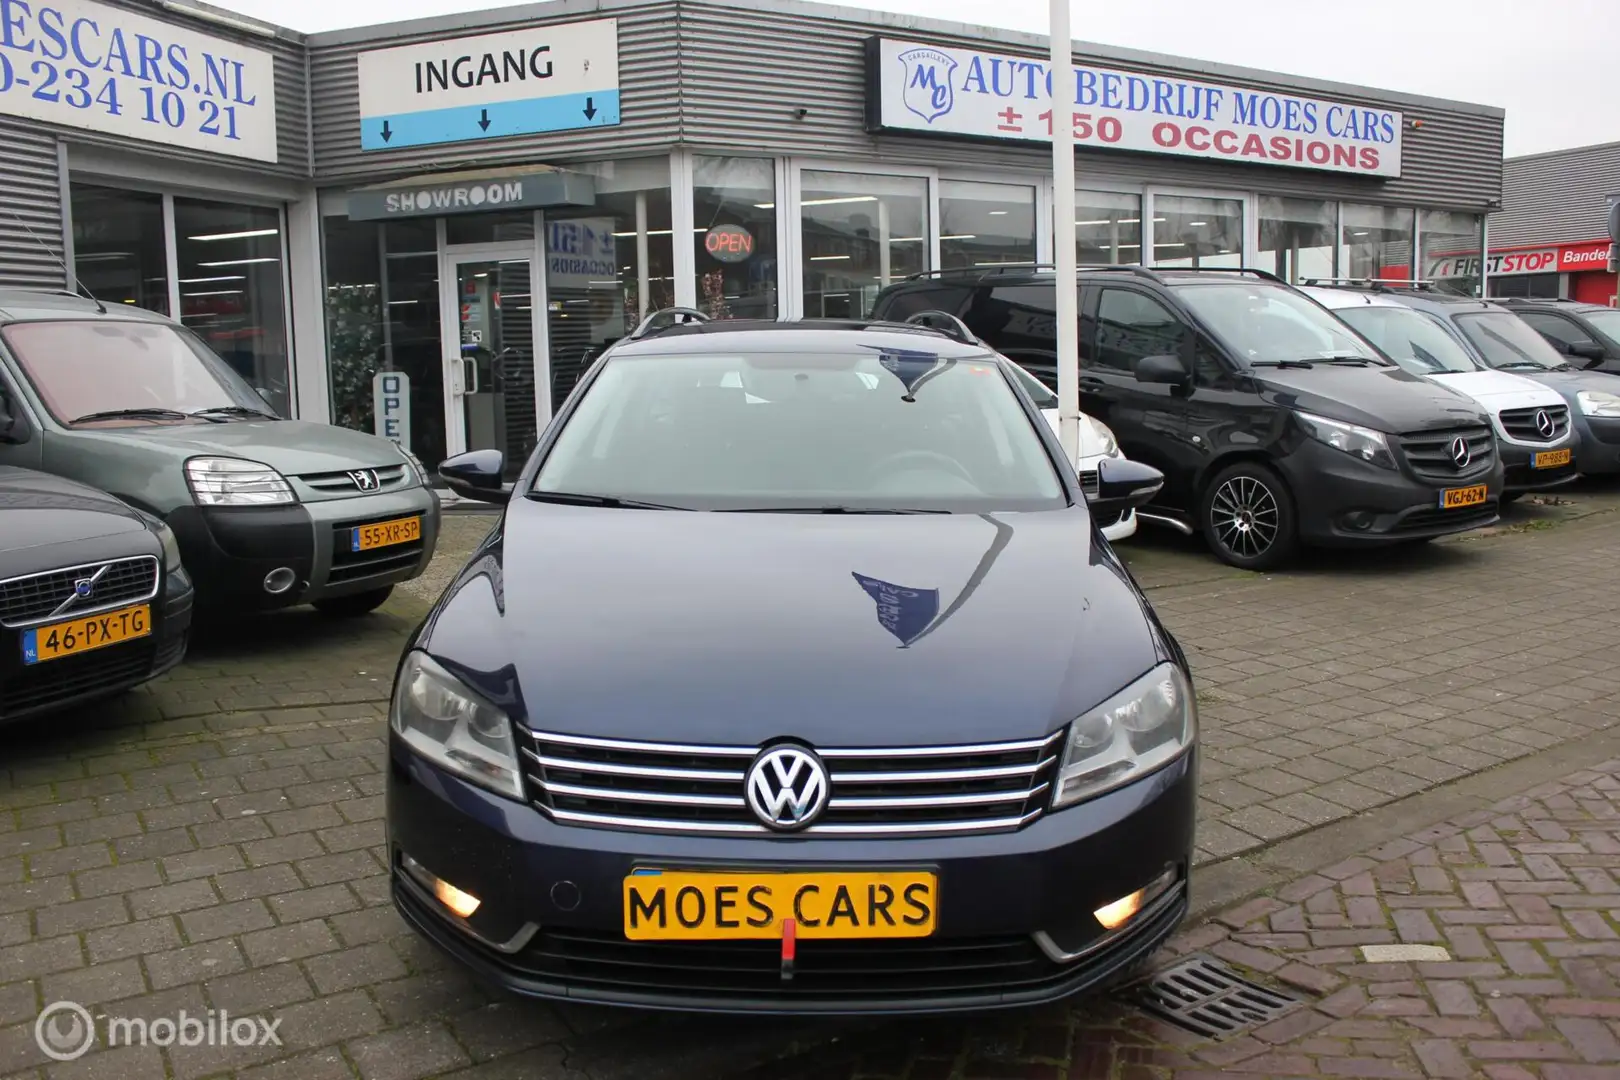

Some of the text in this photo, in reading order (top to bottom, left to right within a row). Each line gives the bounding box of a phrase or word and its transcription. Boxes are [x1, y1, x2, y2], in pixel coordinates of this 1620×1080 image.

[415, 45, 553, 94] INGANG
[140, 86, 186, 128] 10
[199, 100, 241, 140] 21
[961, 55, 1394, 144] AUTBEDRIJF MOES CARS
[1152, 122, 1380, 170] OCCASIONS
[386, 182, 523, 213] SHOWROOM
[705, 232, 753, 253] OPEN
[382, 376, 401, 443] OPE
[364, 521, 418, 546] 55-XR-SP
[25, 649, 36, 658] NL
[45, 610, 143, 653] 46-PX-TG
[628, 883, 931, 929] MOES CARS
